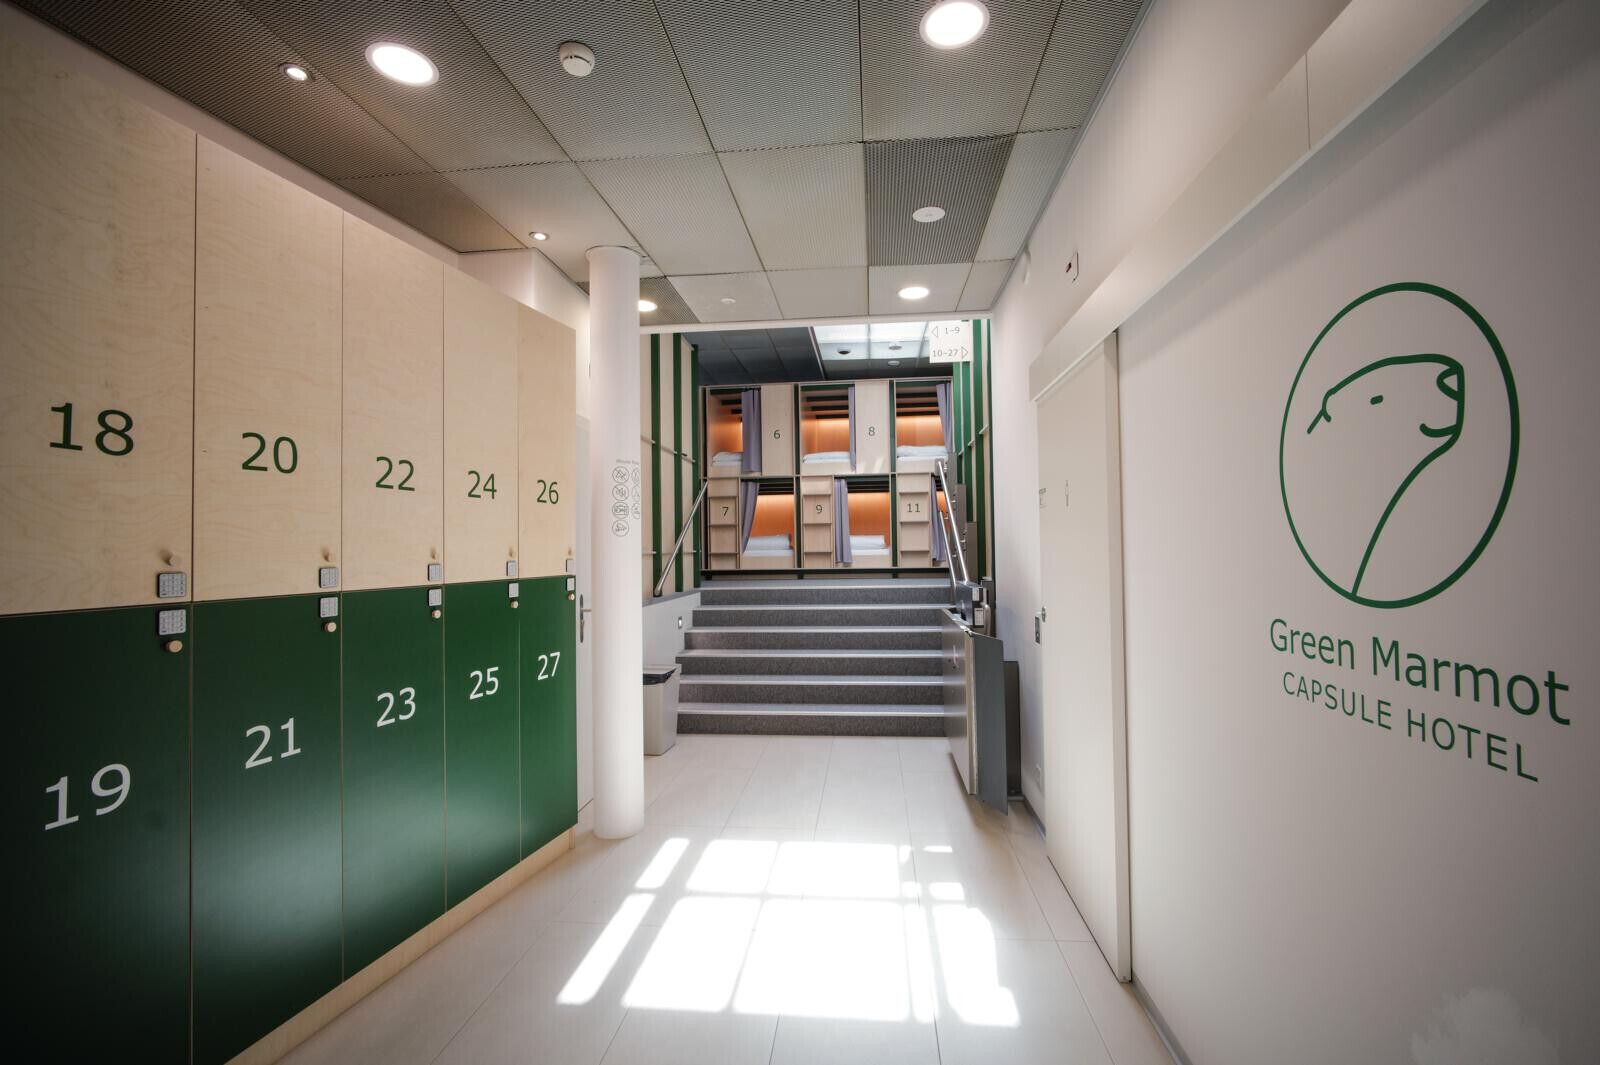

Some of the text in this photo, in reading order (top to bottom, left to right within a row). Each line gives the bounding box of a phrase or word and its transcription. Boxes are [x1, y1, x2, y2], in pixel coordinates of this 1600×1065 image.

[945, 326, 960, 335] 1-9
[932, 348, 958, 358] 10-27
[49, 402, 134, 457] 18
[773, 429, 781, 440] 6
[868, 426, 876, 437] 8
[241, 431, 298, 475] 20
[375, 456, 416, 492] 22
[467, 470, 498, 500] 24
[536, 479, 559, 505] 26
[722, 506, 729, 517] 7
[815, 504, 823, 514] 9
[907, 503, 921, 513] 11
[537, 651, 561, 681] 27
[1270, 618, 1570, 726] Green Marmot
[469, 666, 499, 700] 25
[376, 686, 416, 728] 23
[1283, 671, 1538, 783] CAPSULE HOTEL
[245, 717, 302, 769] 21
[44, 763, 131, 831] 19
